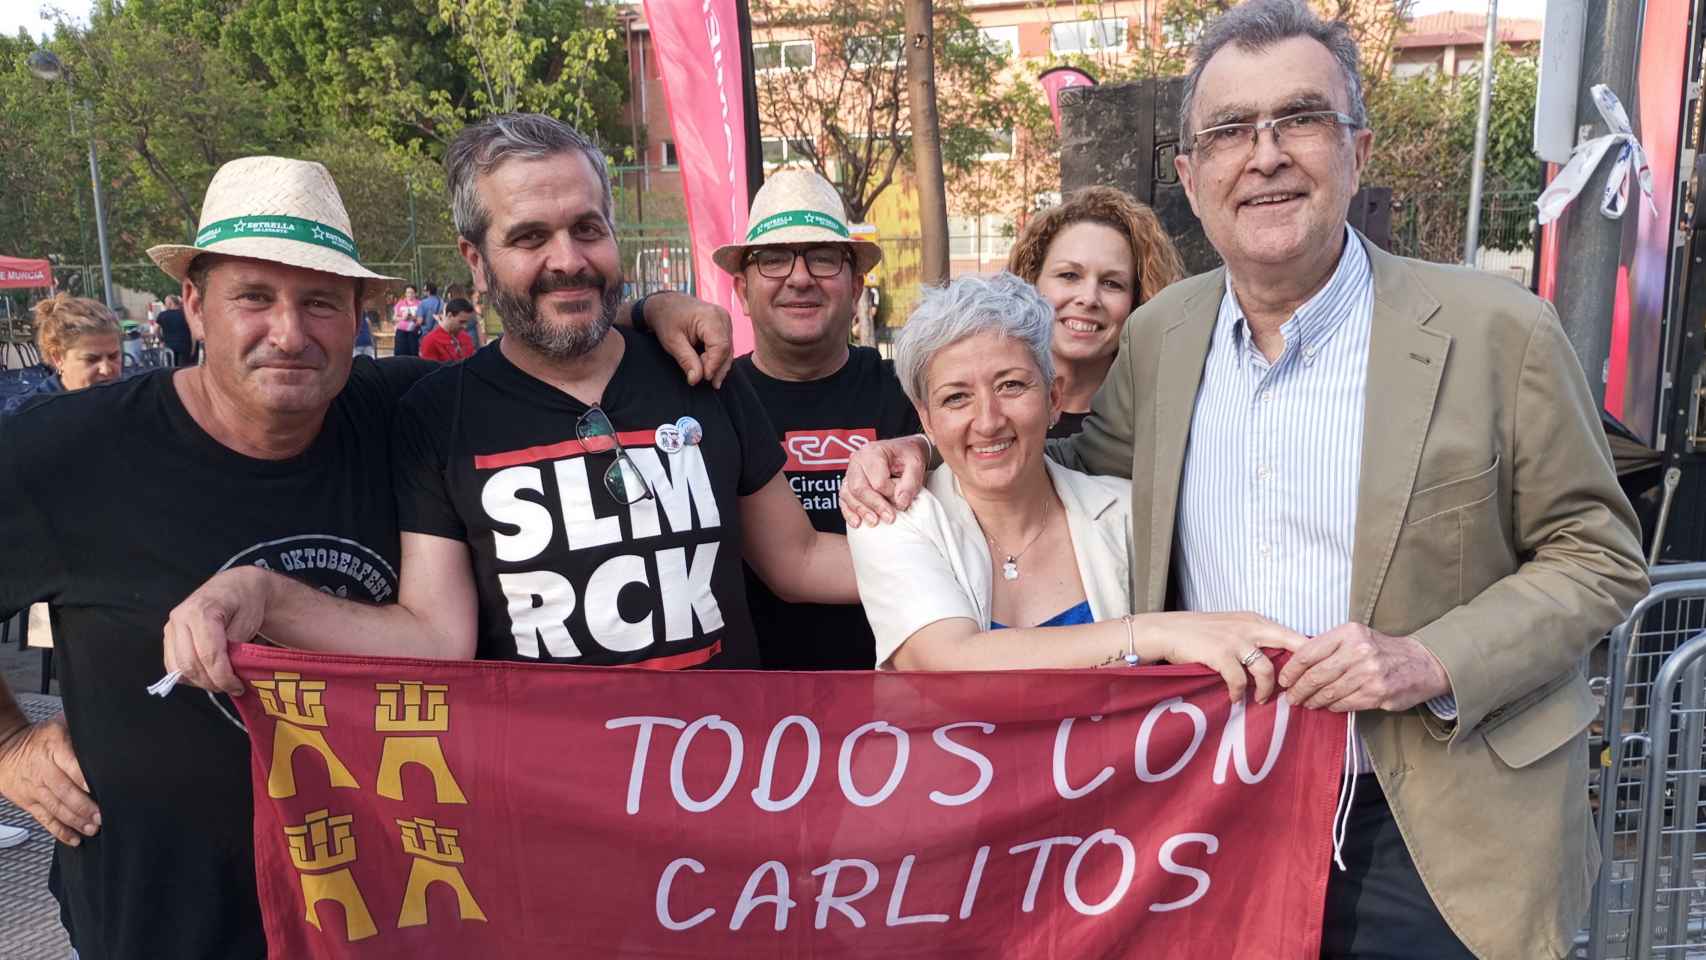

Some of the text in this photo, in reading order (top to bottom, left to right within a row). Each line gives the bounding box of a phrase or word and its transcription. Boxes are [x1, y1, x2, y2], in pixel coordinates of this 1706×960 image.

[247, 222, 295, 231] ESTRELLA
[8, 271, 44, 280] MURCIA
[481, 445, 721, 562] SLM
[789, 475, 842, 492] Circui
[794, 492, 838, 510] atal
[280, 548, 393, 602] OKTOBERFEST
[498, 541, 725, 659] RCK
[605, 691, 1291, 815] TODOS CON
[655, 828, 1219, 931] CARLITOS
